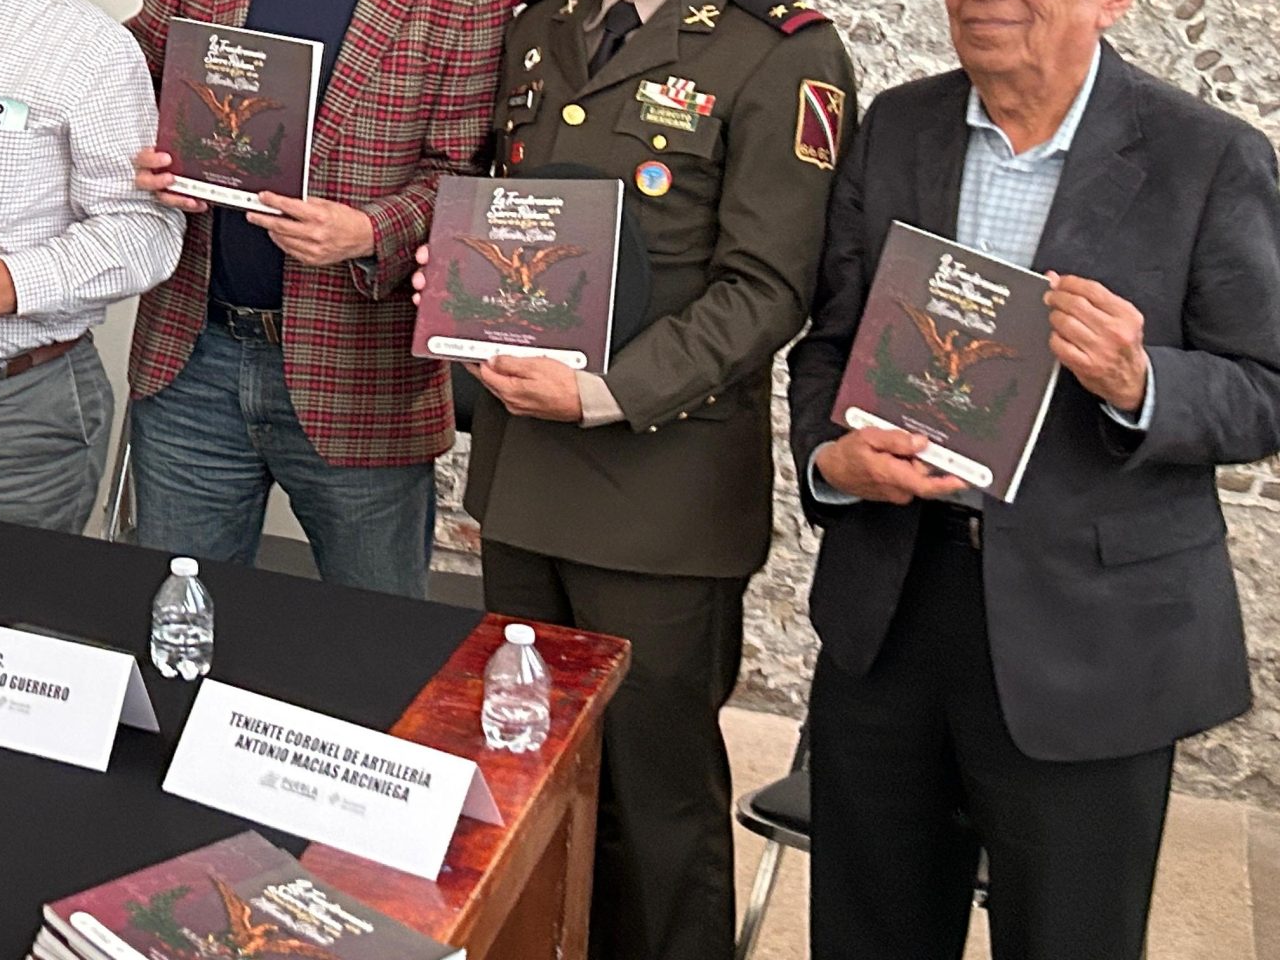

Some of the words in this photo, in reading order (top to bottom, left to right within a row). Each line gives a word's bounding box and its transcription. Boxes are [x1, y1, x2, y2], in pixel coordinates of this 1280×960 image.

[9, 675, 70, 701] GUERRERO
[229, 711, 284, 741] TENIENTE
[285, 729, 340, 759] CORONEL
[342, 747, 361, 765] DE
[234, 734, 289, 763] ANTONIO
[290, 751, 341, 781] MACIAS
[341, 767, 411, 802] ARCINIEGA
